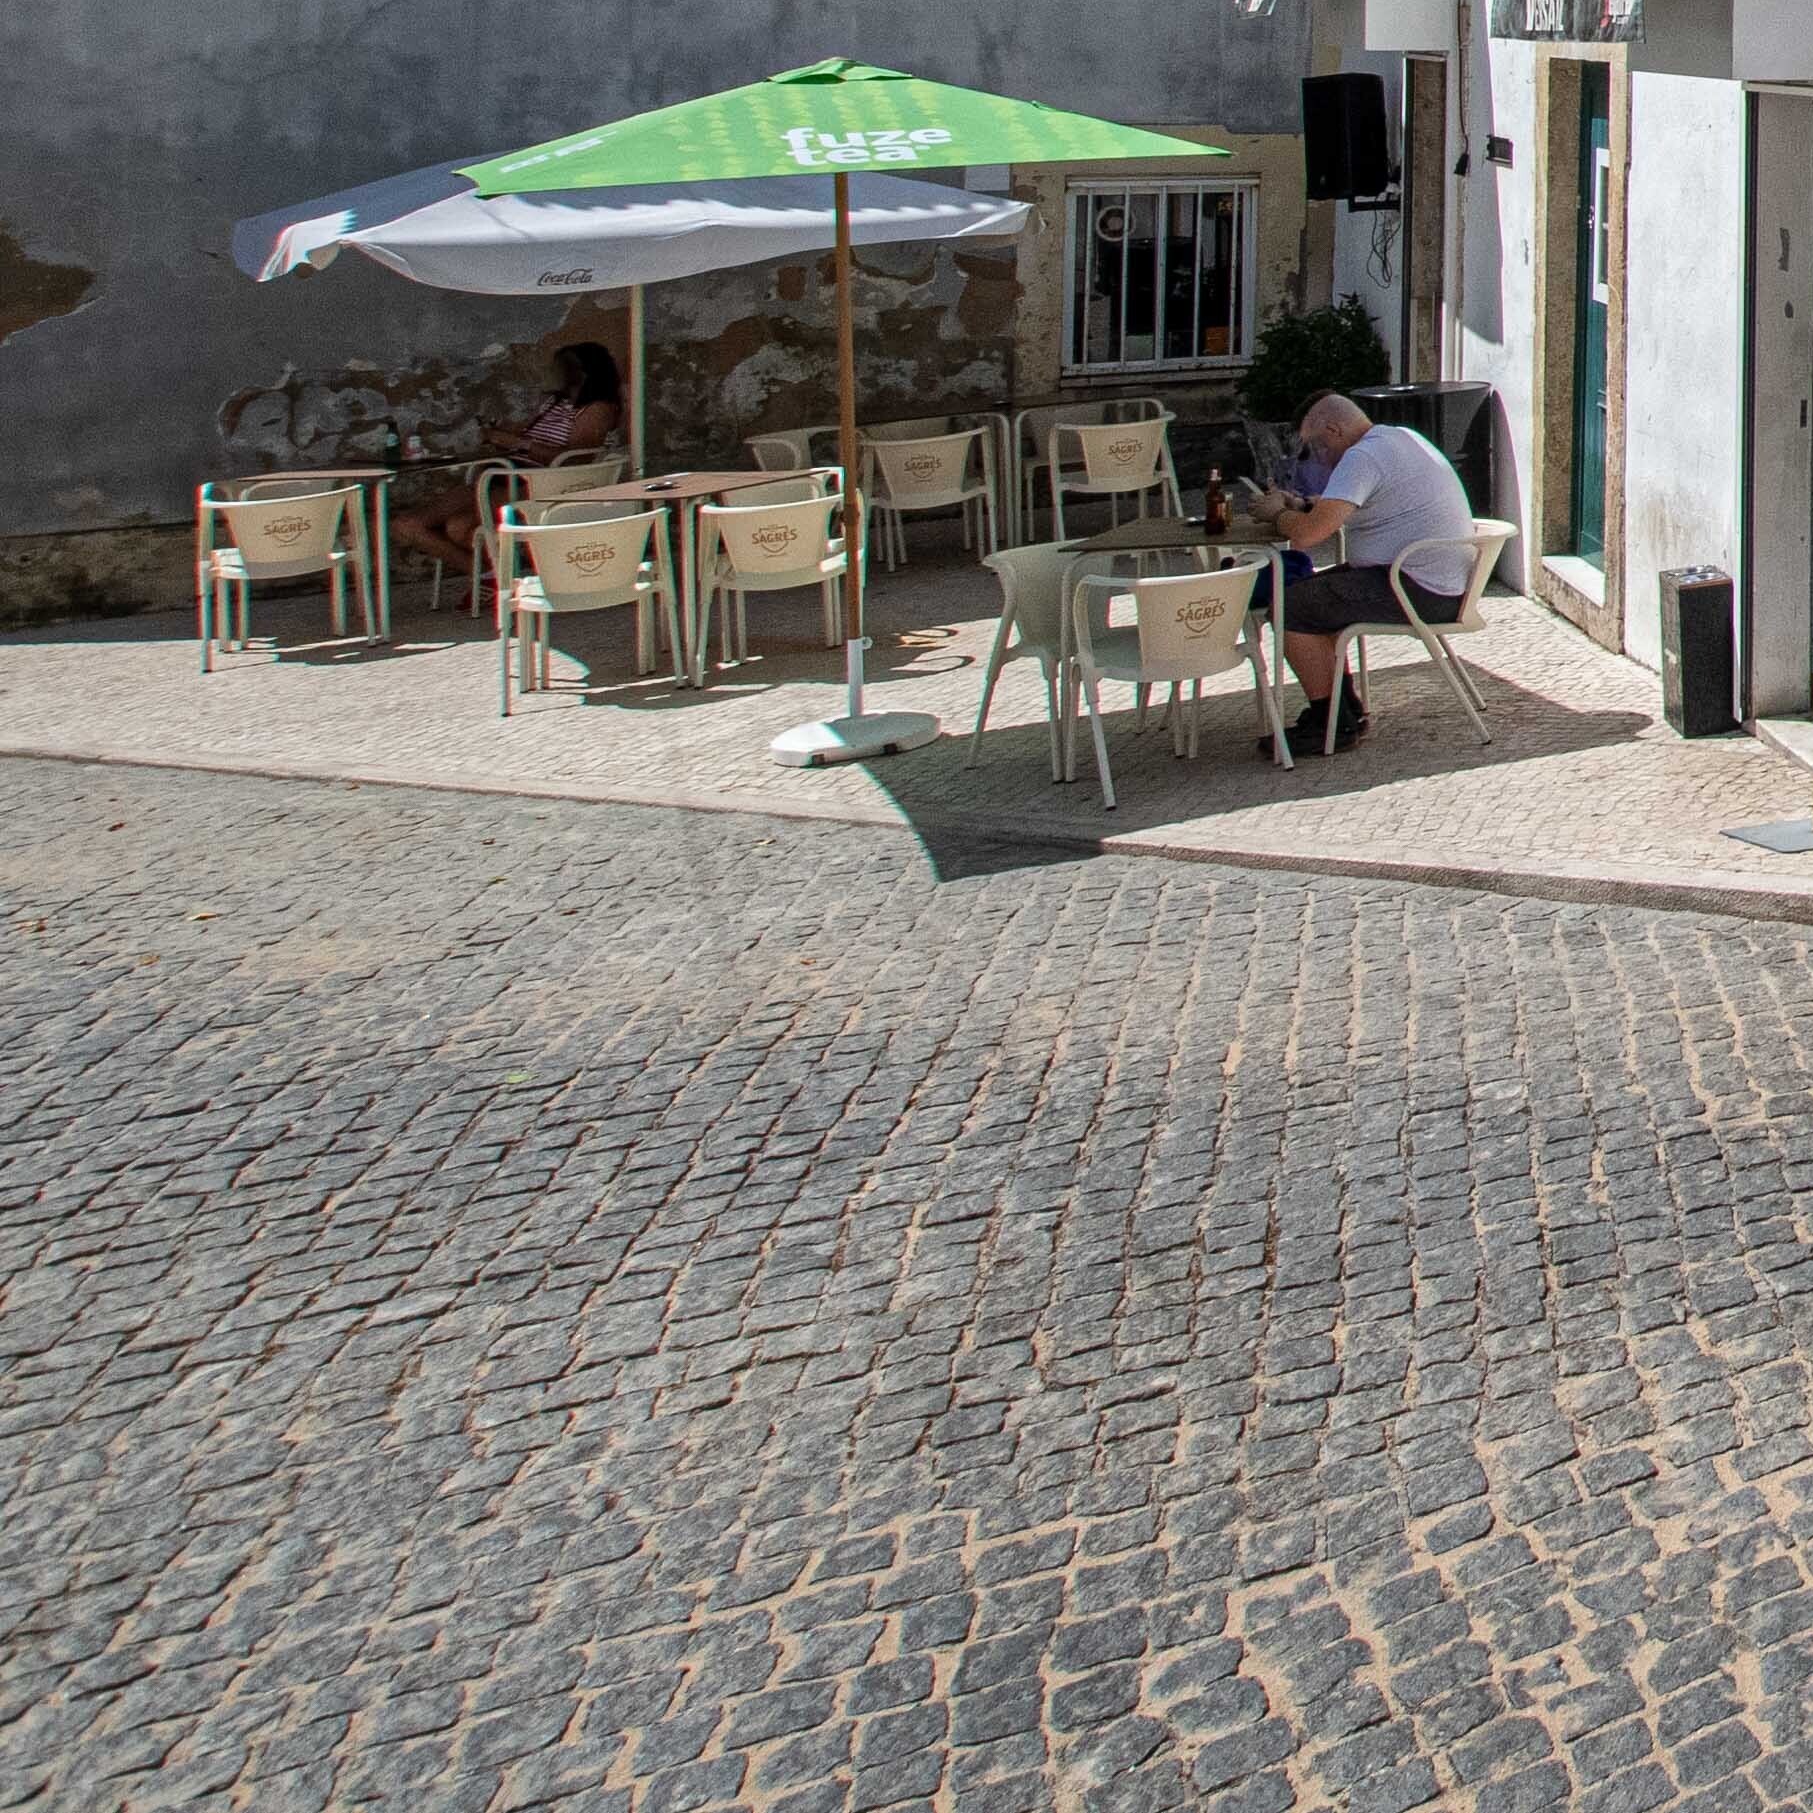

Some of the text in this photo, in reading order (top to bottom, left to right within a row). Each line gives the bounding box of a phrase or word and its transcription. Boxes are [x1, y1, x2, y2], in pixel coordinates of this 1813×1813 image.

[780, 127, 952, 149] fuze
[786, 147, 919, 166] tea
[264, 519, 312, 536] SAGRES
[751, 529, 798, 545] SAGRES
[566, 547, 616, 564] SAGRES
[1174, 601, 1226, 622] SAGRES
